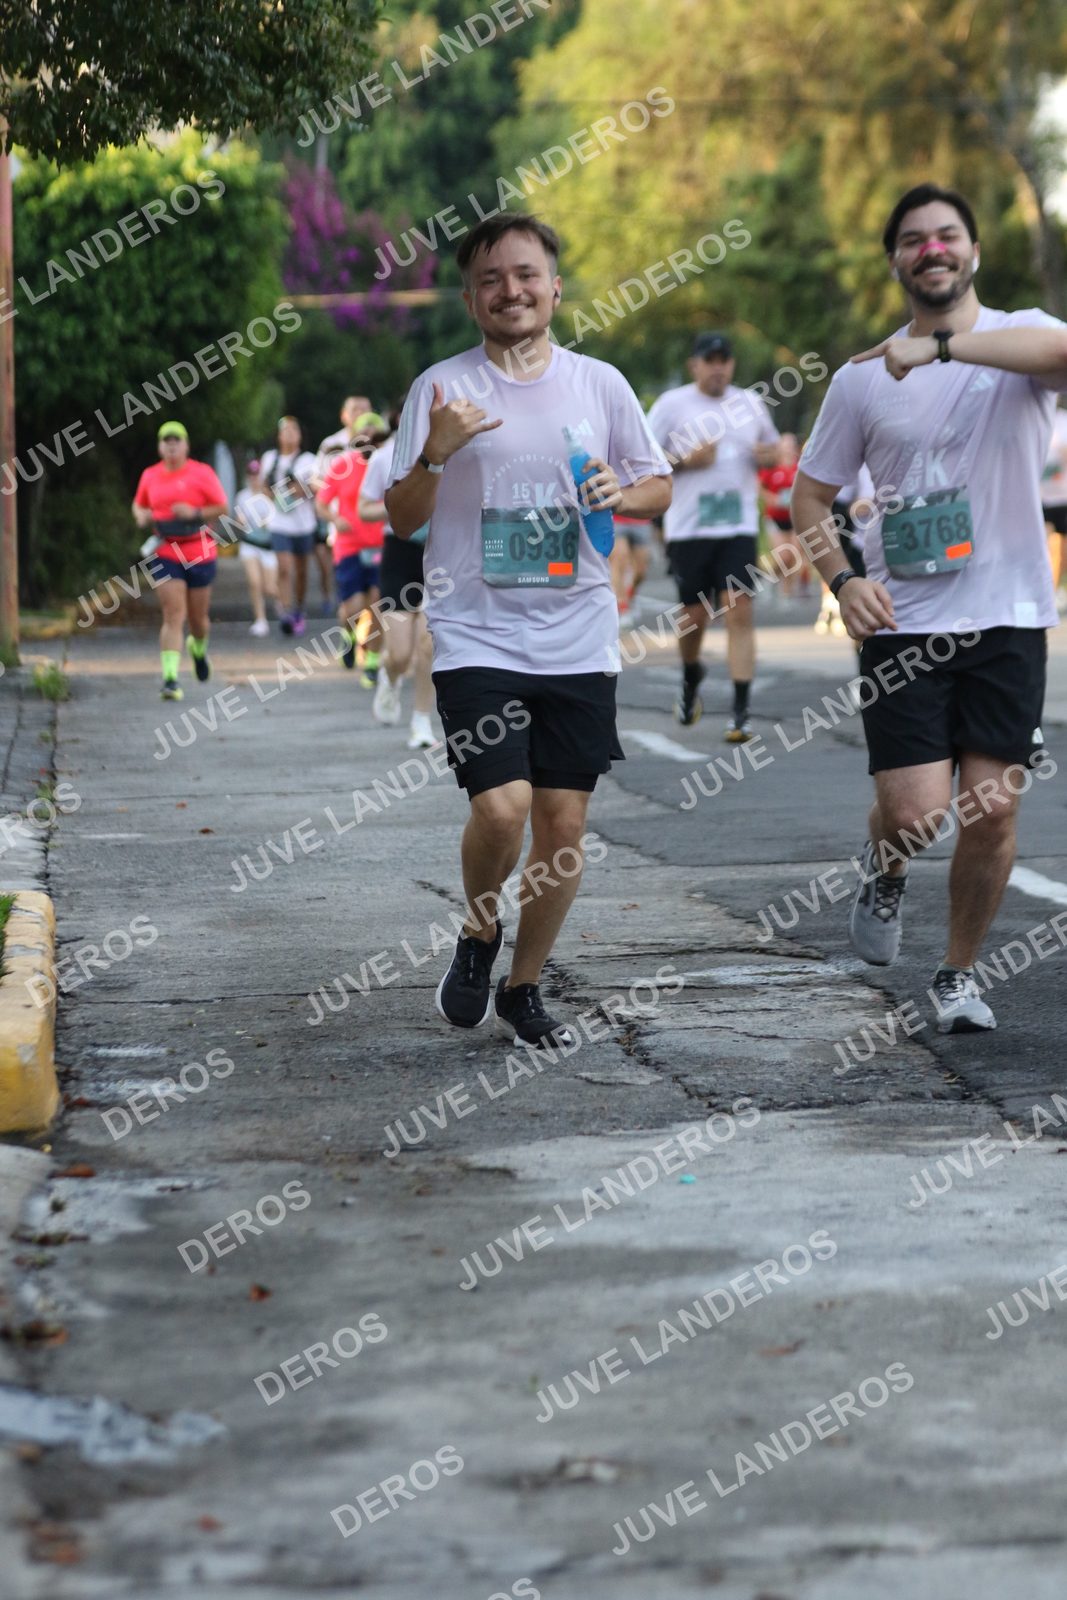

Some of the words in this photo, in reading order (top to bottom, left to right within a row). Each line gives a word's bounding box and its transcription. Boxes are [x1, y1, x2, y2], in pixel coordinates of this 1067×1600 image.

[926, 448, 949, 488] K
[512, 482, 531, 499] 15
[509, 531, 576, 561] 0936
[902, 511, 972, 552] 3768
[517, 576, 550, 584] SAMSUNG
